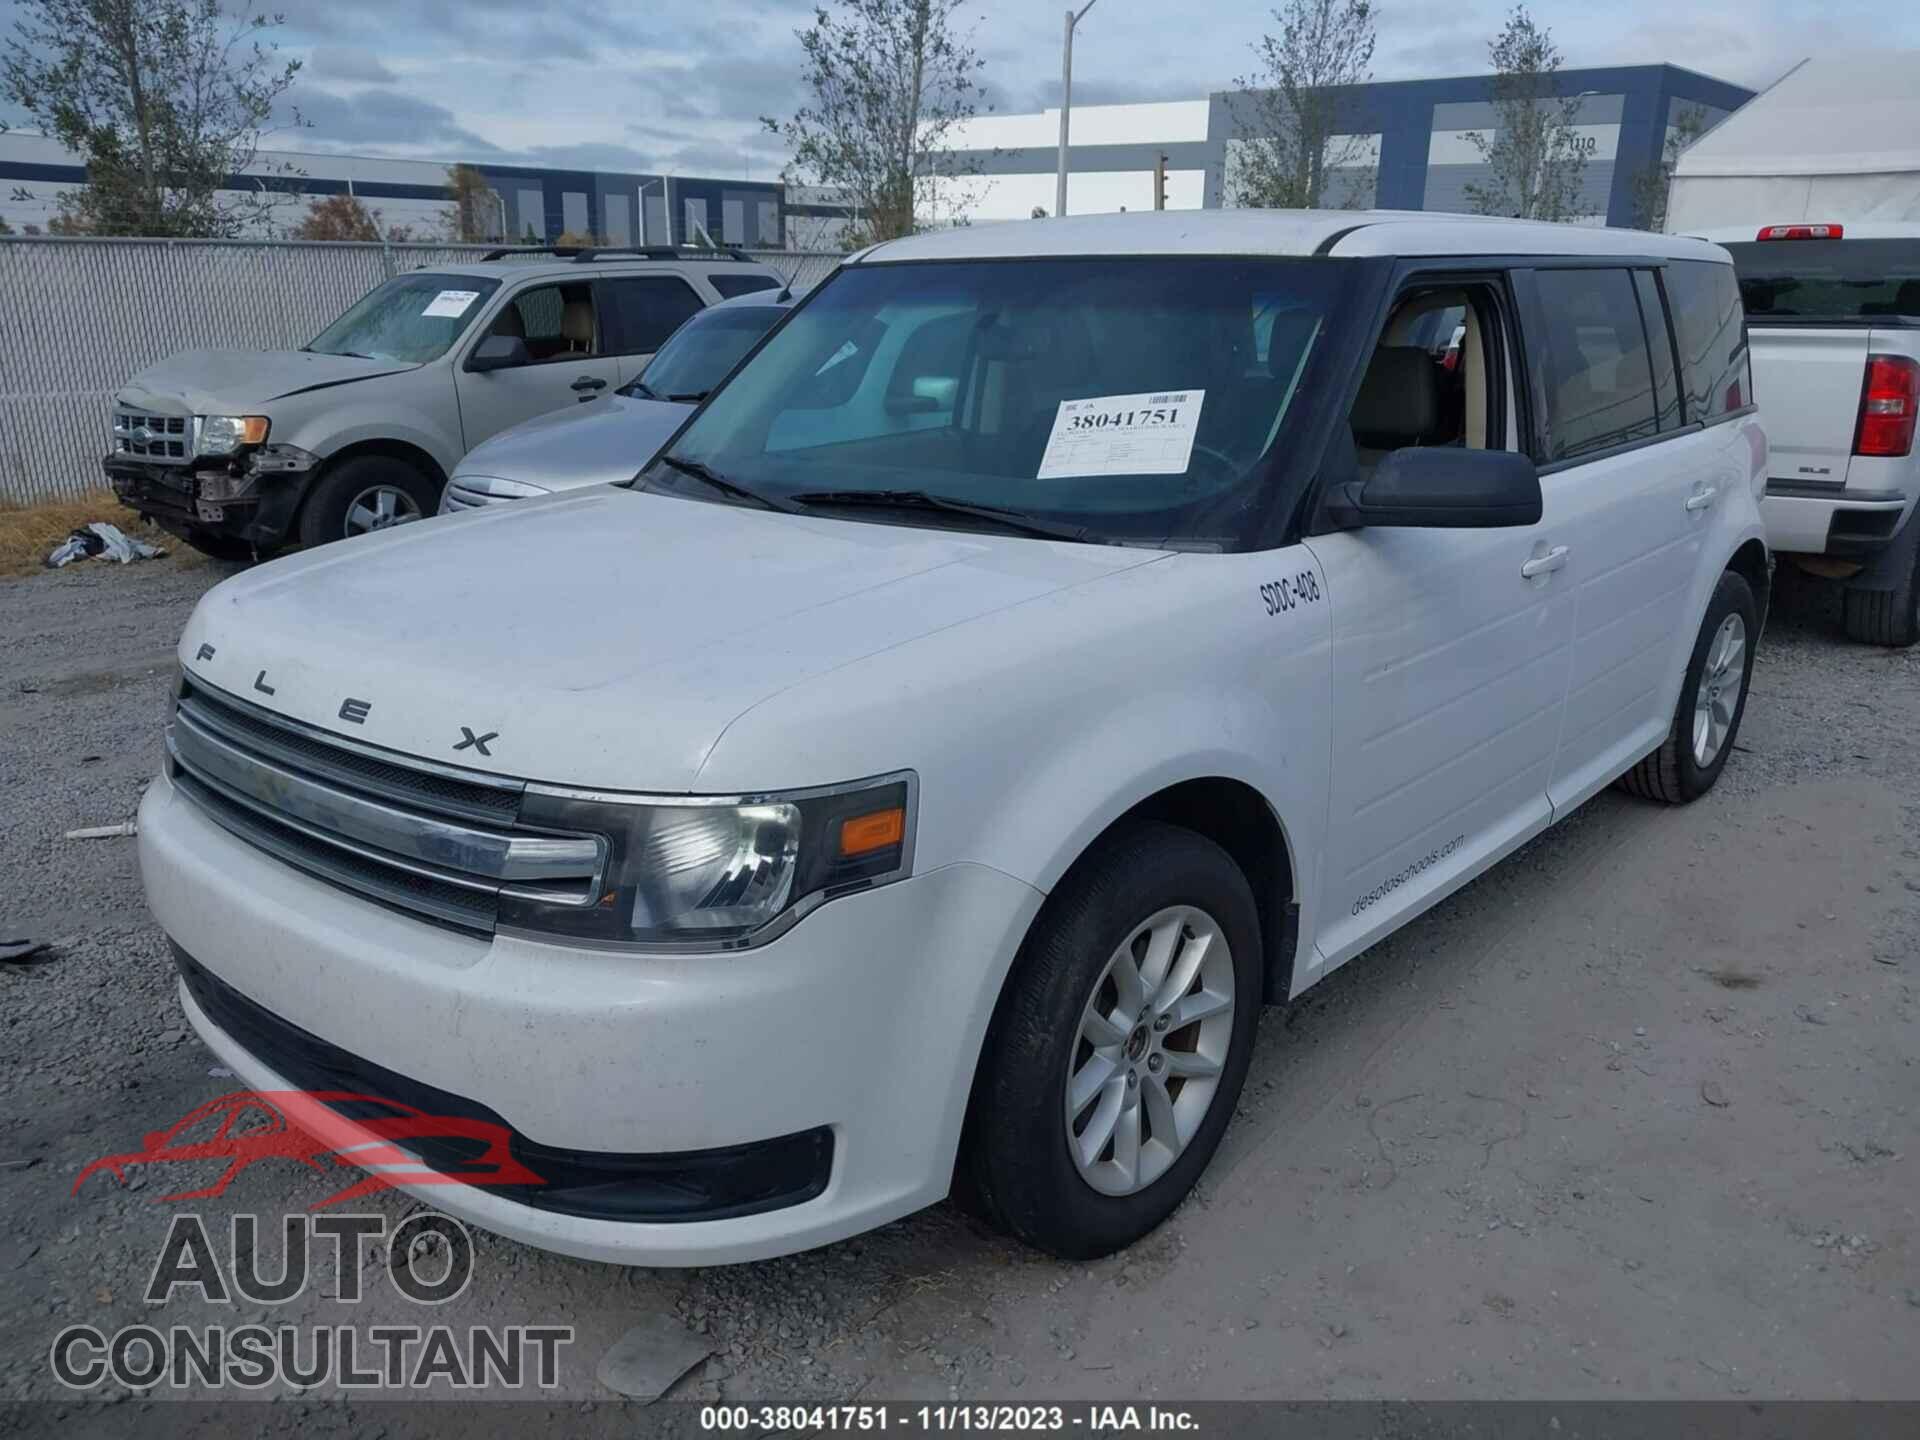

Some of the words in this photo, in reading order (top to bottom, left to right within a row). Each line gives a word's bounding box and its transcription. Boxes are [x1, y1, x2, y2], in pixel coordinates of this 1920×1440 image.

[1066, 408, 1179, 431] 38041751
[1259, 570, 1320, 616] SDDC-408
[196, 643, 499, 756] FLEX
[1351, 834, 1465, 916] desotoschools.com
